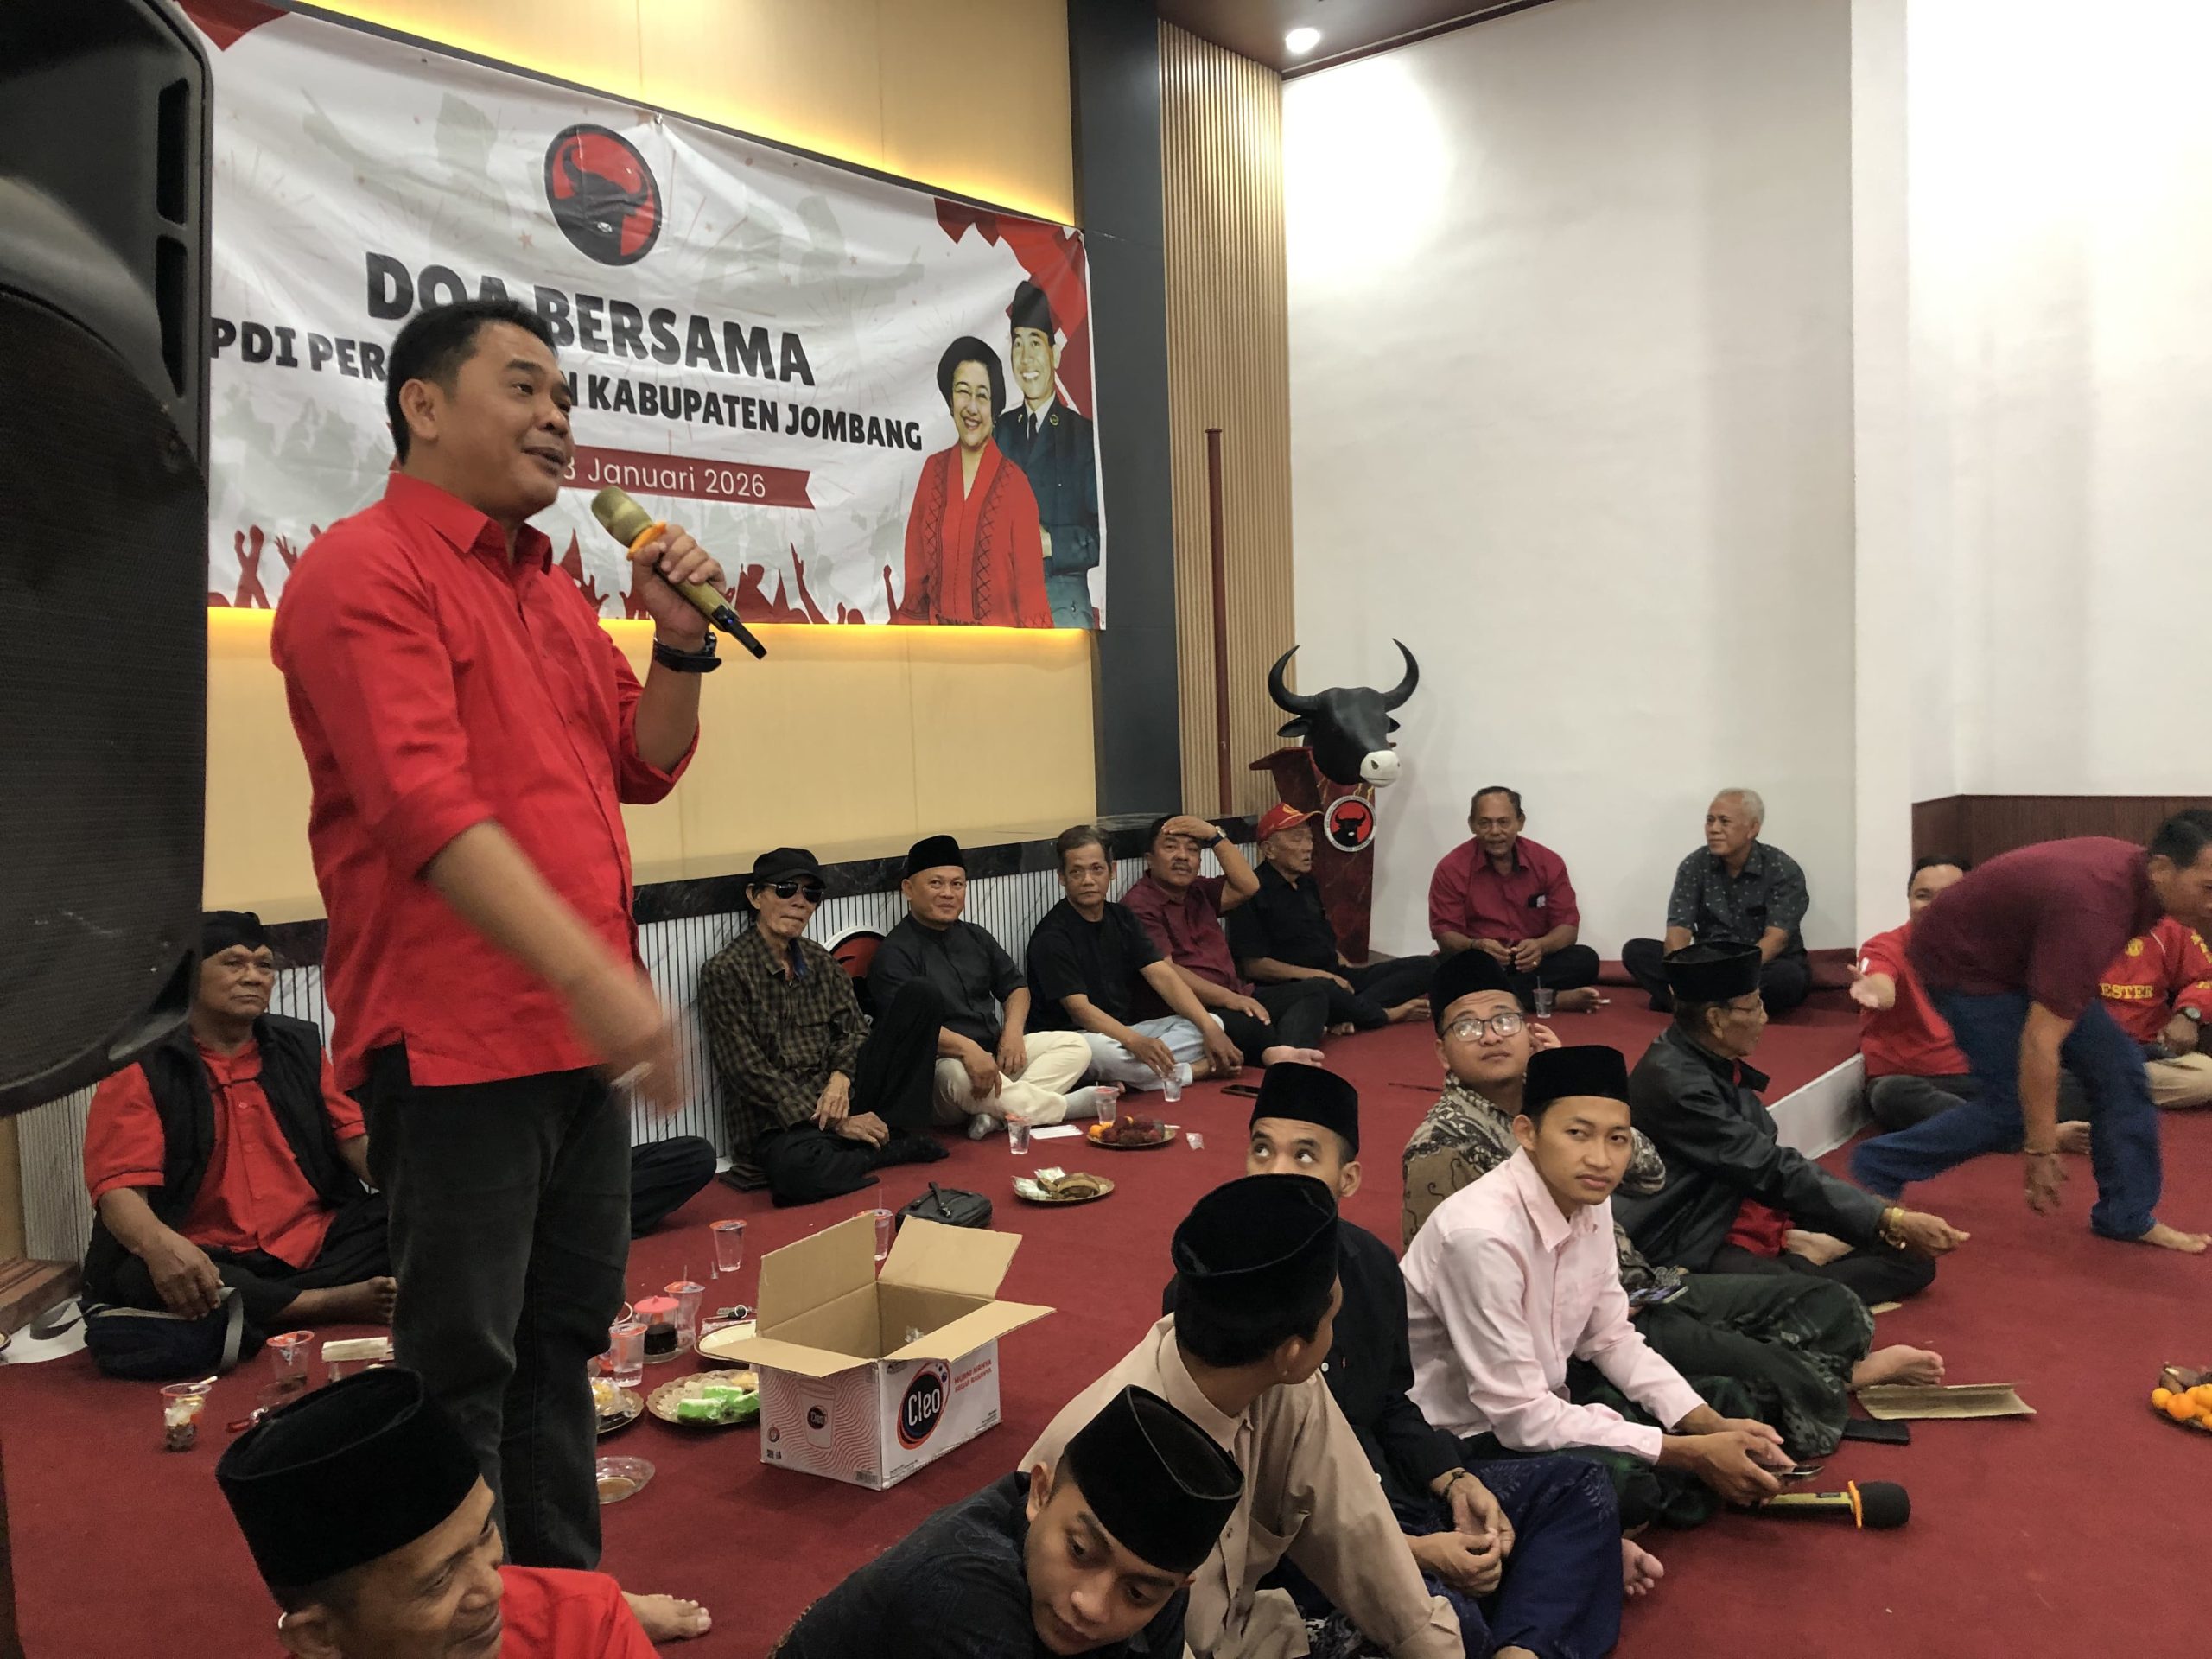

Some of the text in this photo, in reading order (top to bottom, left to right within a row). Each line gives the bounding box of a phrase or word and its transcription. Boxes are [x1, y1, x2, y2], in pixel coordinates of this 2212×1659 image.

[534, 285, 816, 386] BERSAMA
[211, 317, 922, 450] PDI KABUPATEN JOMBANG
[588, 457, 695, 492] Januari
[704, 469, 766, 498] 2026
[908, 1388, 940, 1427] Cleo
